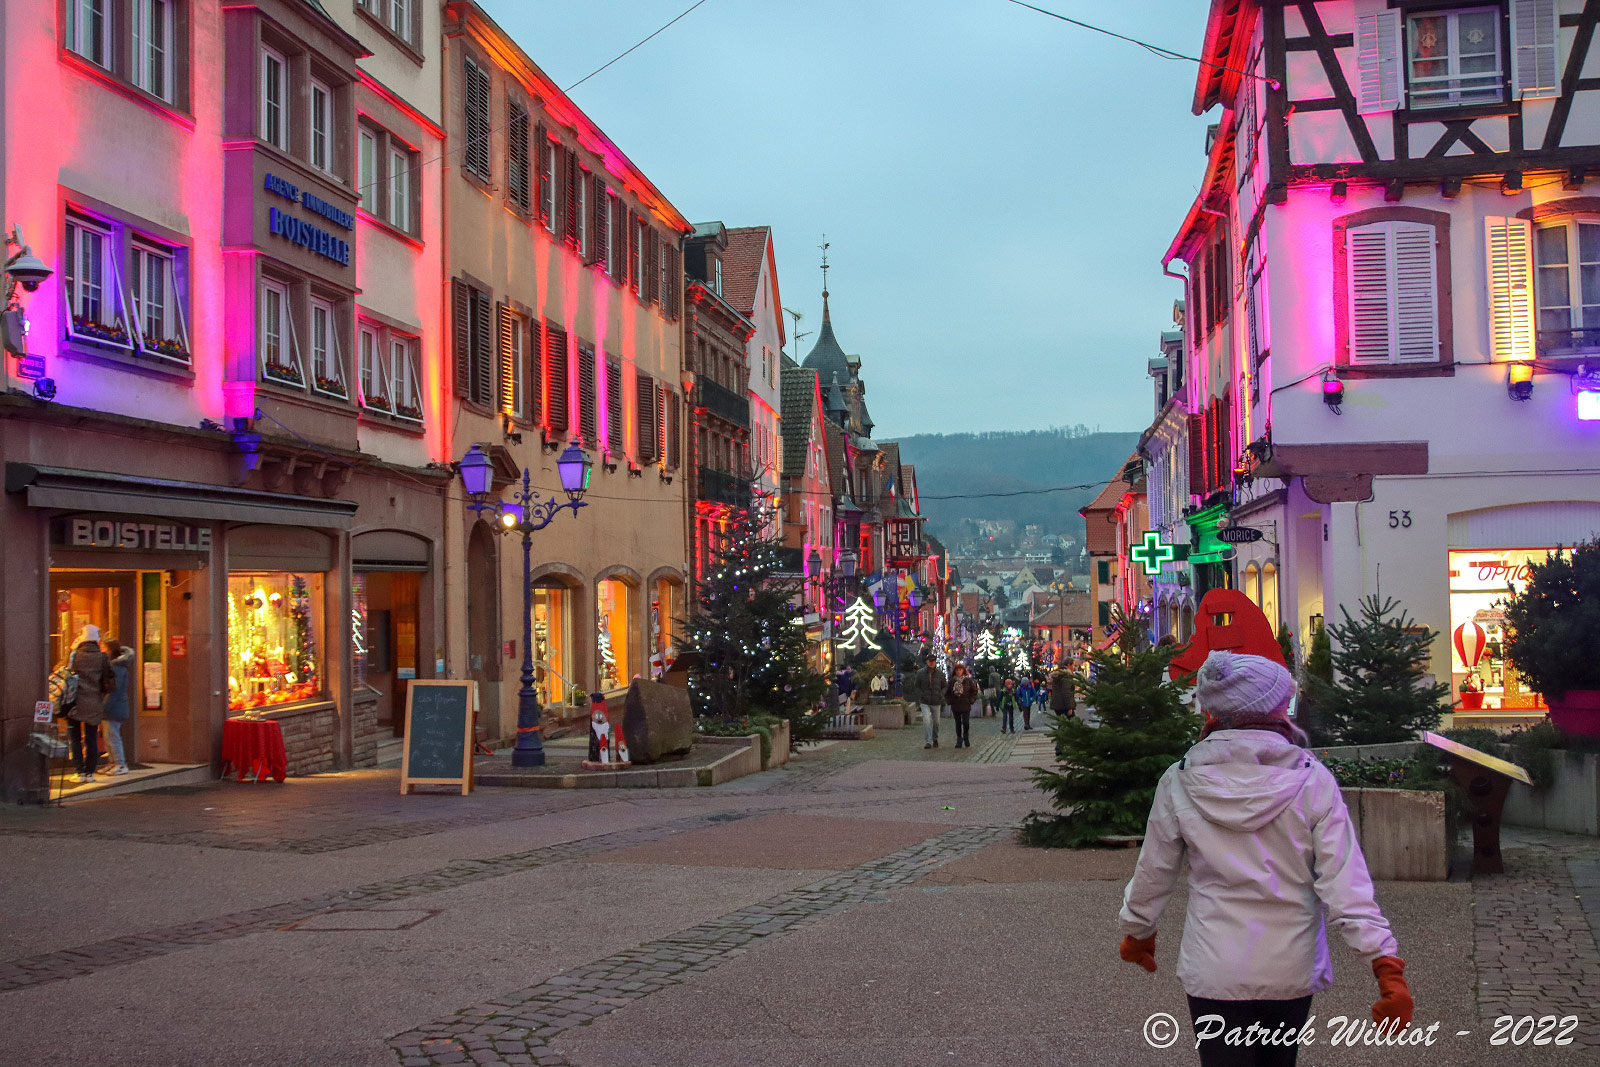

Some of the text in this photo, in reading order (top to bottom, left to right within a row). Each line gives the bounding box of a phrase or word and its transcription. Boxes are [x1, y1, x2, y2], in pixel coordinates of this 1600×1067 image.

[264, 173, 299, 202] AGENCE
[270, 207, 349, 266] BOISTELLE
[1389, 509, 1412, 528] 53
[73, 518, 212, 551] BOISTELLE
[1223, 530, 1256, 541] MORICE
[1478, 564, 1534, 581] OPTIQ
